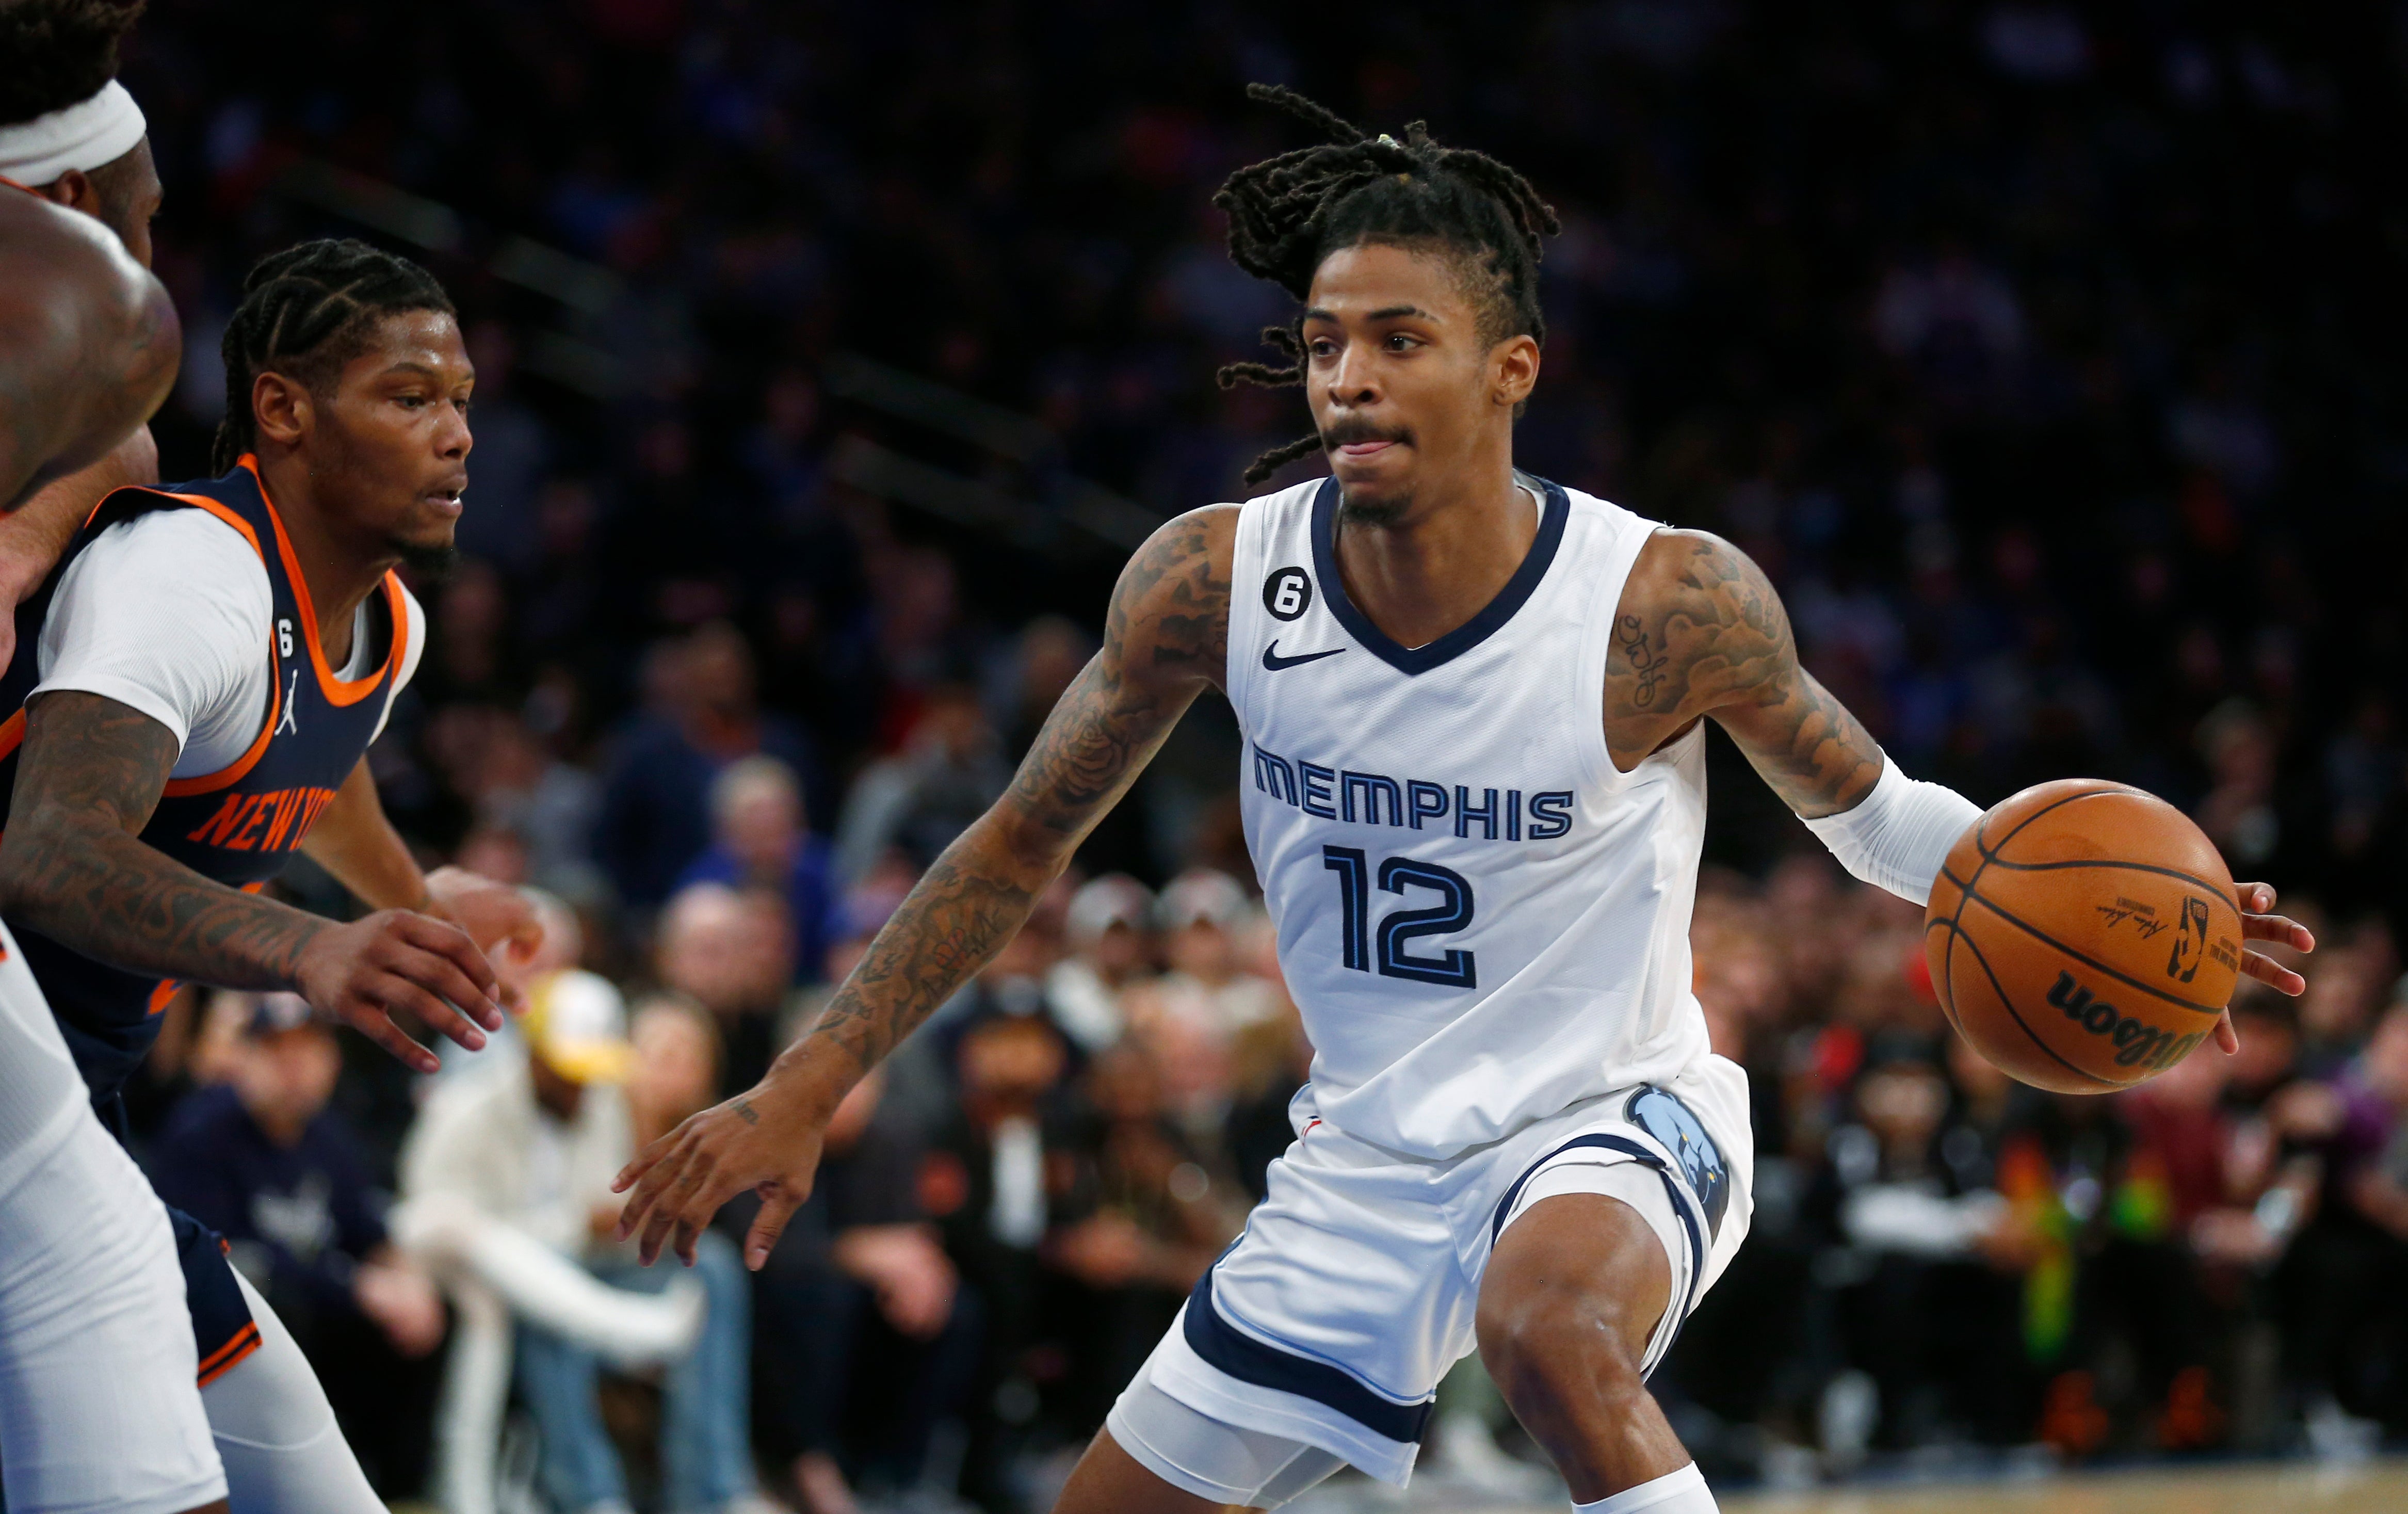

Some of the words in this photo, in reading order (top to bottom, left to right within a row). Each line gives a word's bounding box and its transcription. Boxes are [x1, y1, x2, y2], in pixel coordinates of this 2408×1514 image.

[1273, 574, 1305, 615] 6
[278, 619, 293, 658] 6
[186, 786, 308, 852] NEW
[1253, 742, 1573, 842] MEMPHIS
[1322, 844, 1477, 989] 12
